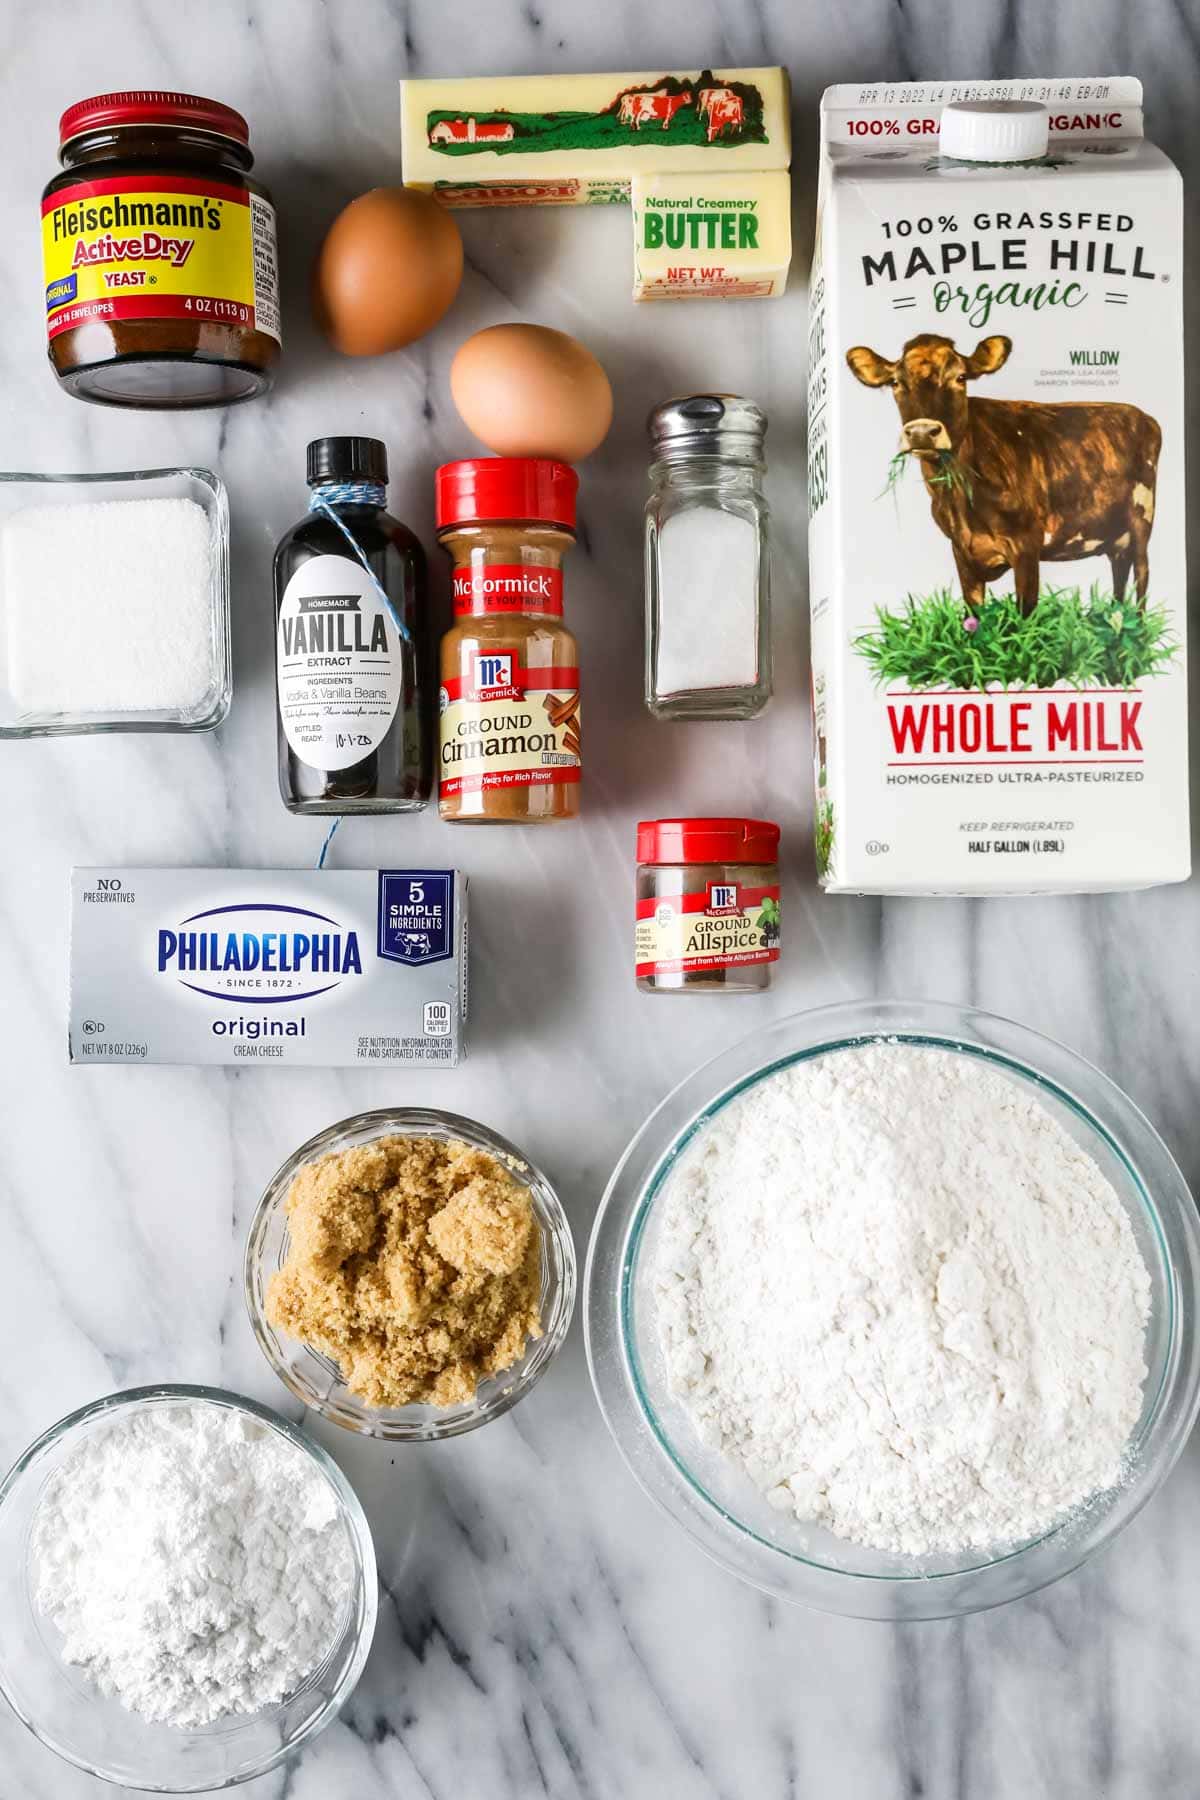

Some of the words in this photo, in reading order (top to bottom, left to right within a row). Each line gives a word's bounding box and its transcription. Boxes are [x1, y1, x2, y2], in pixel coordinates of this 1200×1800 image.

[846, 119, 900, 137] 100%
[645, 197, 693, 208] Natural
[696, 197, 758, 210] Creamery
[53, 196, 222, 241] Fleischmann's
[881, 214, 959, 239] 100%
[973, 212, 1135, 233] GRASSFED
[644, 212, 760, 249] BUTTER
[861, 239, 1028, 286] MAPLE
[104, 271, 146, 288] YEAST
[667, 267, 697, 279] NET
[184, 298, 193, 311] 4
[195, 299, 211, 313] OZ
[932, 278, 1089, 329] organic
[71, 303, 114, 320] ENVELOPES
[1069, 350, 1120, 366] WILLOW
[453, 575, 551, 597] McCormick
[307, 599, 351, 609] HOMEMADE
[282, 613, 389, 657] VANILLA
[307, 657, 352, 667] EXTRACT
[307, 677, 353, 686] INGREDIENTS
[310, 688, 318, 699] &
[320, 687, 351, 699] Vanilla
[354, 687, 387, 699] Beans
[457, 714, 532, 736] GROUND
[886, 702, 1033, 753] WHOLE
[1047, 701, 1144, 752] MILK
[441, 732, 557, 764] Cinnamon
[503, 774, 514, 782] for
[515, 772, 531, 781] Rich
[531, 771, 552, 780] Flavor
[886, 772, 994, 786] HOMOGENIZED
[998, 771, 1144, 785] ULTRA-PASTEURIZED
[958, 822, 988, 832] KEEP
[990, 821, 1075, 832] REFRIGERATED
[968, 840, 992, 853] HALF
[994, 840, 1030, 853] GALLON
[97, 879, 122, 891] NO
[408, 881, 425, 903] 5
[83, 892, 136, 904] PRESERVATIVES
[390, 905, 442, 916] SIMPLE
[389, 917, 442, 930] INGREDIENTS
[695, 917, 752, 933] GROUND
[686, 930, 757, 953] Allspice
[158, 929, 363, 974] PHILADELPHIA
[697, 957, 712, 965] from
[226, 979, 262, 988] SINCE
[266, 979, 293, 988] 1872
[428, 1005, 447, 1019] 100
[212, 1016, 306, 1039] original
[82, 1043, 96, 1055] NET
[96, 1043, 107, 1055] WT
[108, 1043, 114, 1055] 8
[114, 1043, 124, 1055] OZ
[124, 1043, 148, 1057] (226g)
[358, 1037, 369, 1048] SEE
[370, 1037, 400, 1048] NUTRITION
[401, 1038, 440, 1049] INFORMATION
[440, 1038, 453, 1049] FOR
[233, 1045, 258, 1057] CREAM
[258, 1045, 284, 1057] CHEESE
[357, 1048, 368, 1058] FAT
[368, 1048, 381, 1058] AND
[381, 1048, 414, 1059] SATURATED
[414, 1048, 424, 1058] FAT
[426, 1049, 453, 1059] CONTENT
